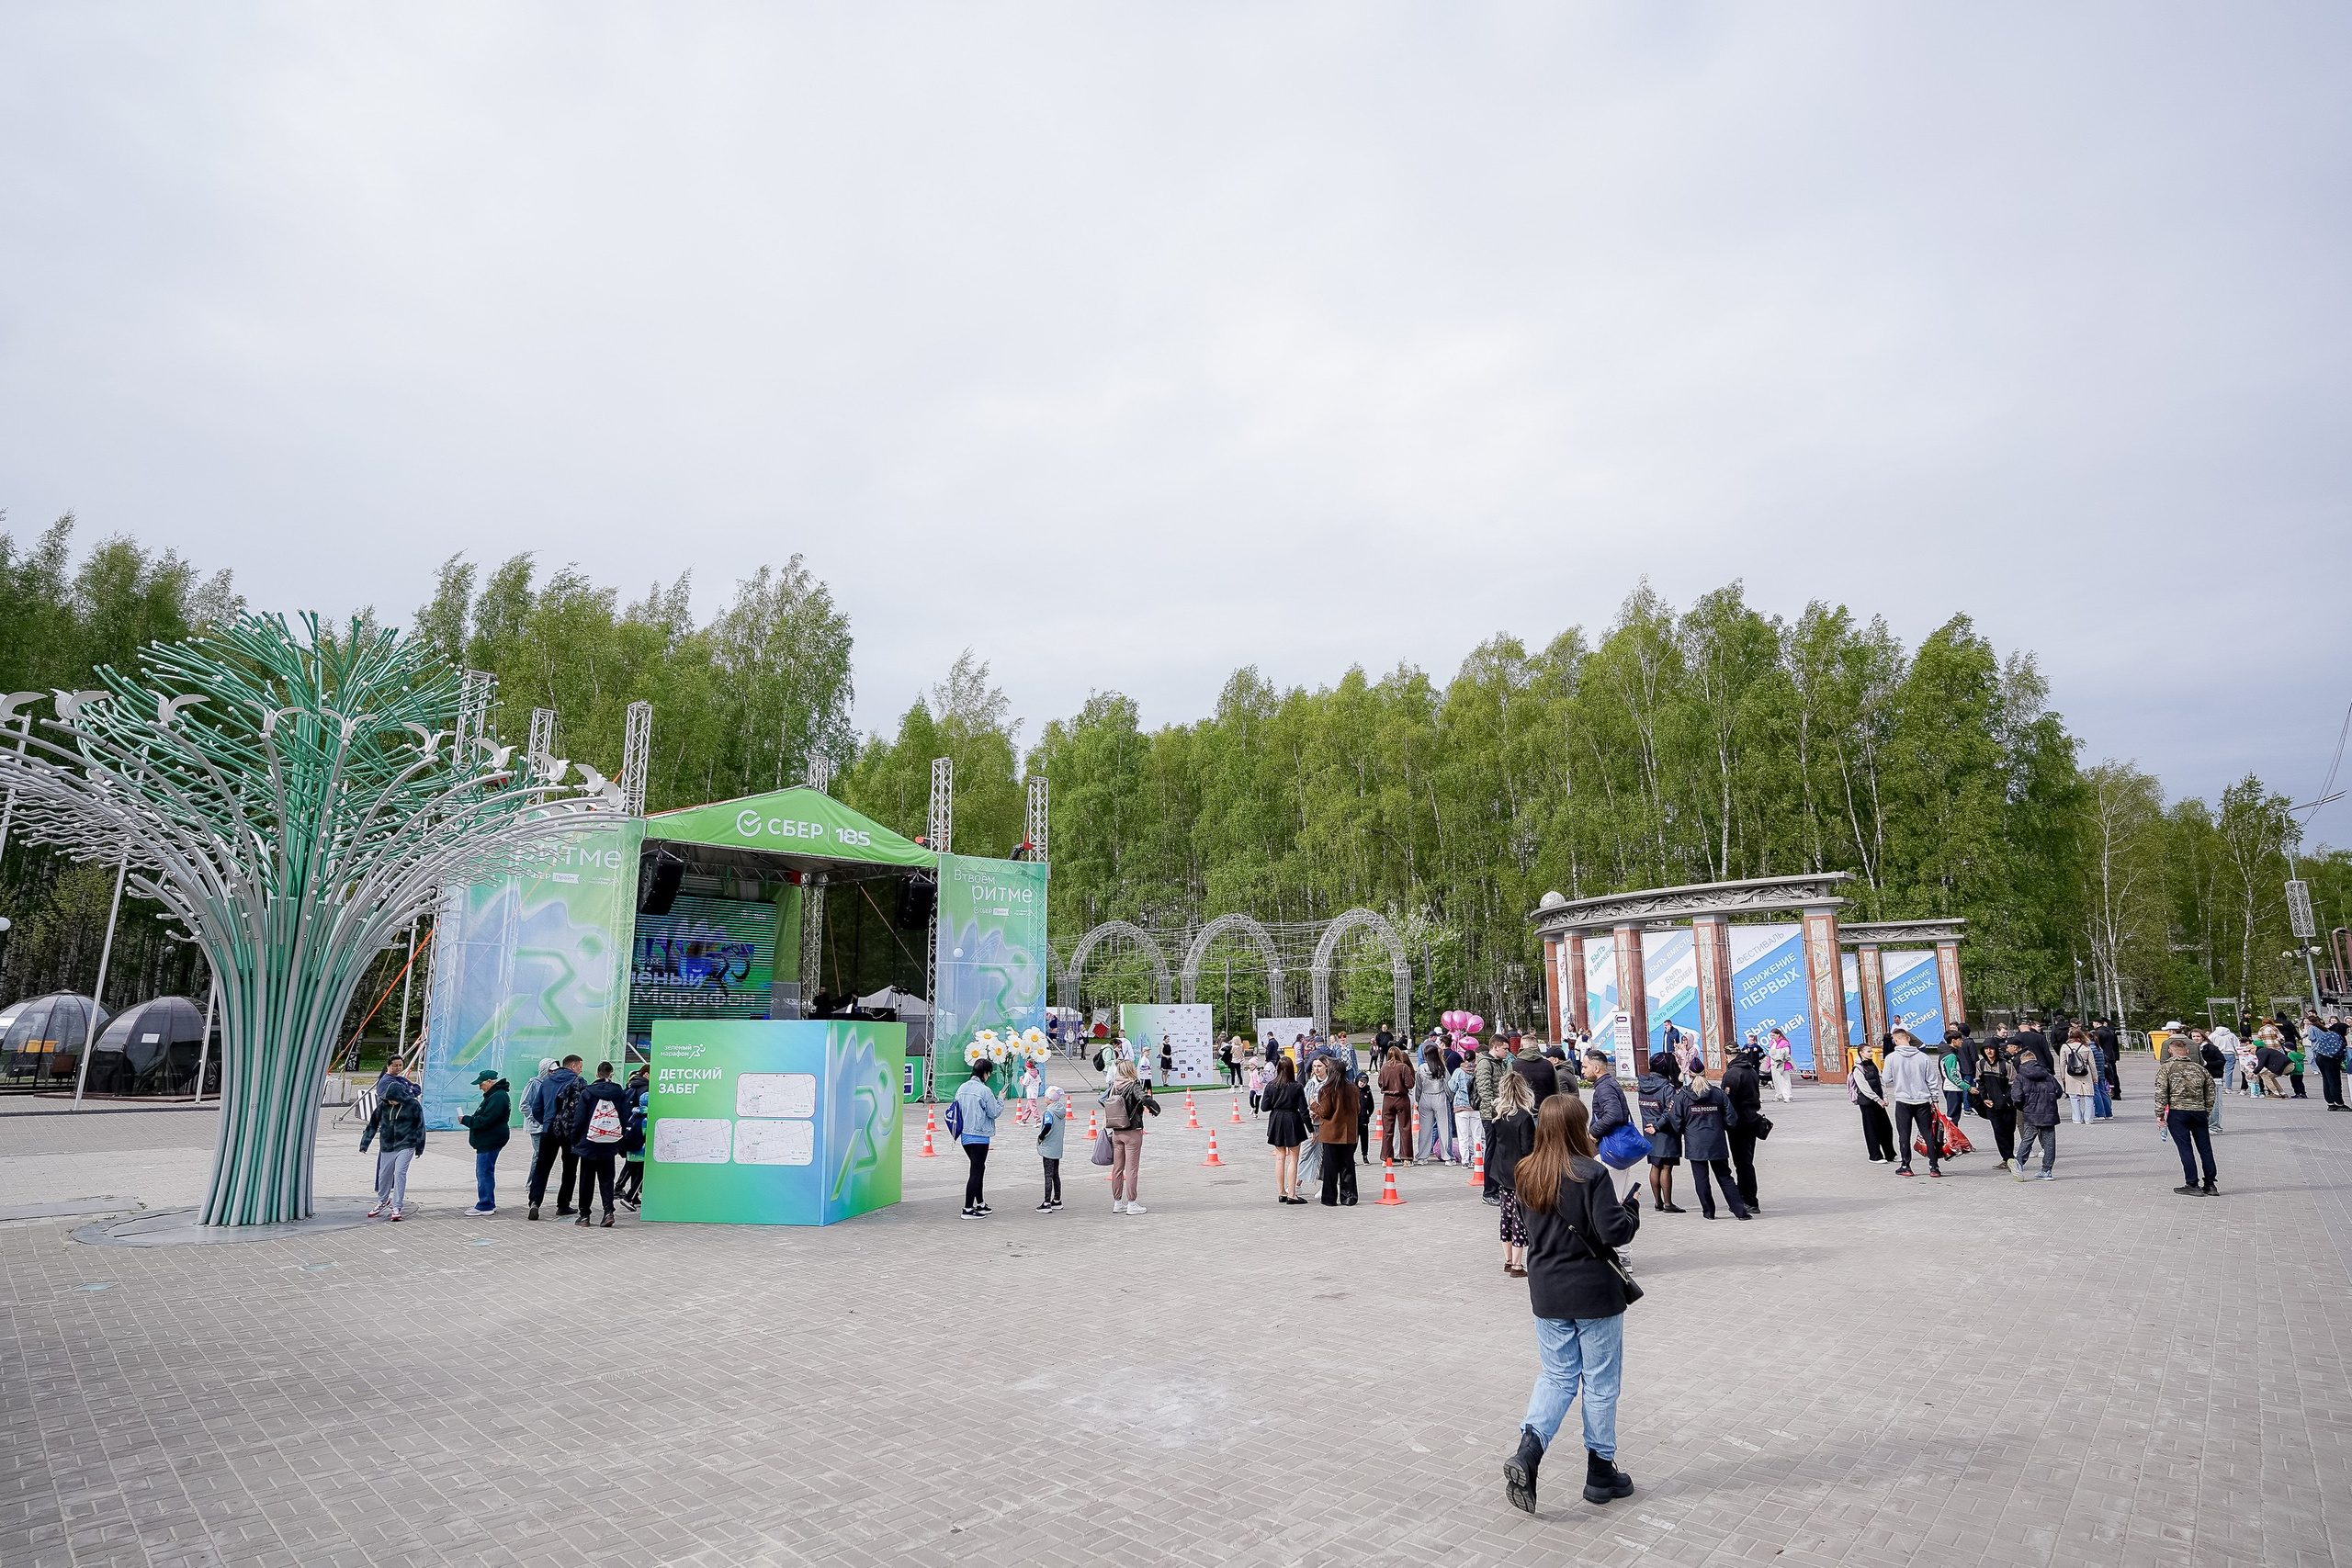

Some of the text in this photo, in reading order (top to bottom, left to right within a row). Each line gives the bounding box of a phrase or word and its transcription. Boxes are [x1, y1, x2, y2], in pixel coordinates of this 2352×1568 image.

[767, 818, 824, 840] СБЕР
[835, 828, 871, 847] 185
[972, 885, 1033, 905] ритме
[1590, 945, 1606, 964] БЫТЬ
[1648, 934, 1691, 974] БЫТЬ ВМЕСТЕ
[1736, 931, 1785, 965] ФЕСТИВАЛЬ
[1665, 967, 1682, 984] БЫТЬ
[1741, 952, 1797, 993] ДВИЖЕНИЕ
[1887, 955, 1923, 977] ФЕСТИВАЛЬ
[1666, 966, 1694, 994] РОССИЕЙ
[1739, 966, 1802, 1010] ПЕРВЫХ
[1892, 968, 1932, 996] ДВИЖЕНИЕ
[1890, 977, 1935, 1007] ПЕРВЫХ
[1901, 1010, 1917, 1023] ЫТЬ
[1906, 1008, 1939, 1031] ОССИЕЙ
[659, 1066, 722, 1081] ДЕТСКИЙ
[658, 1083, 700, 1094] ЗАБЕГ
